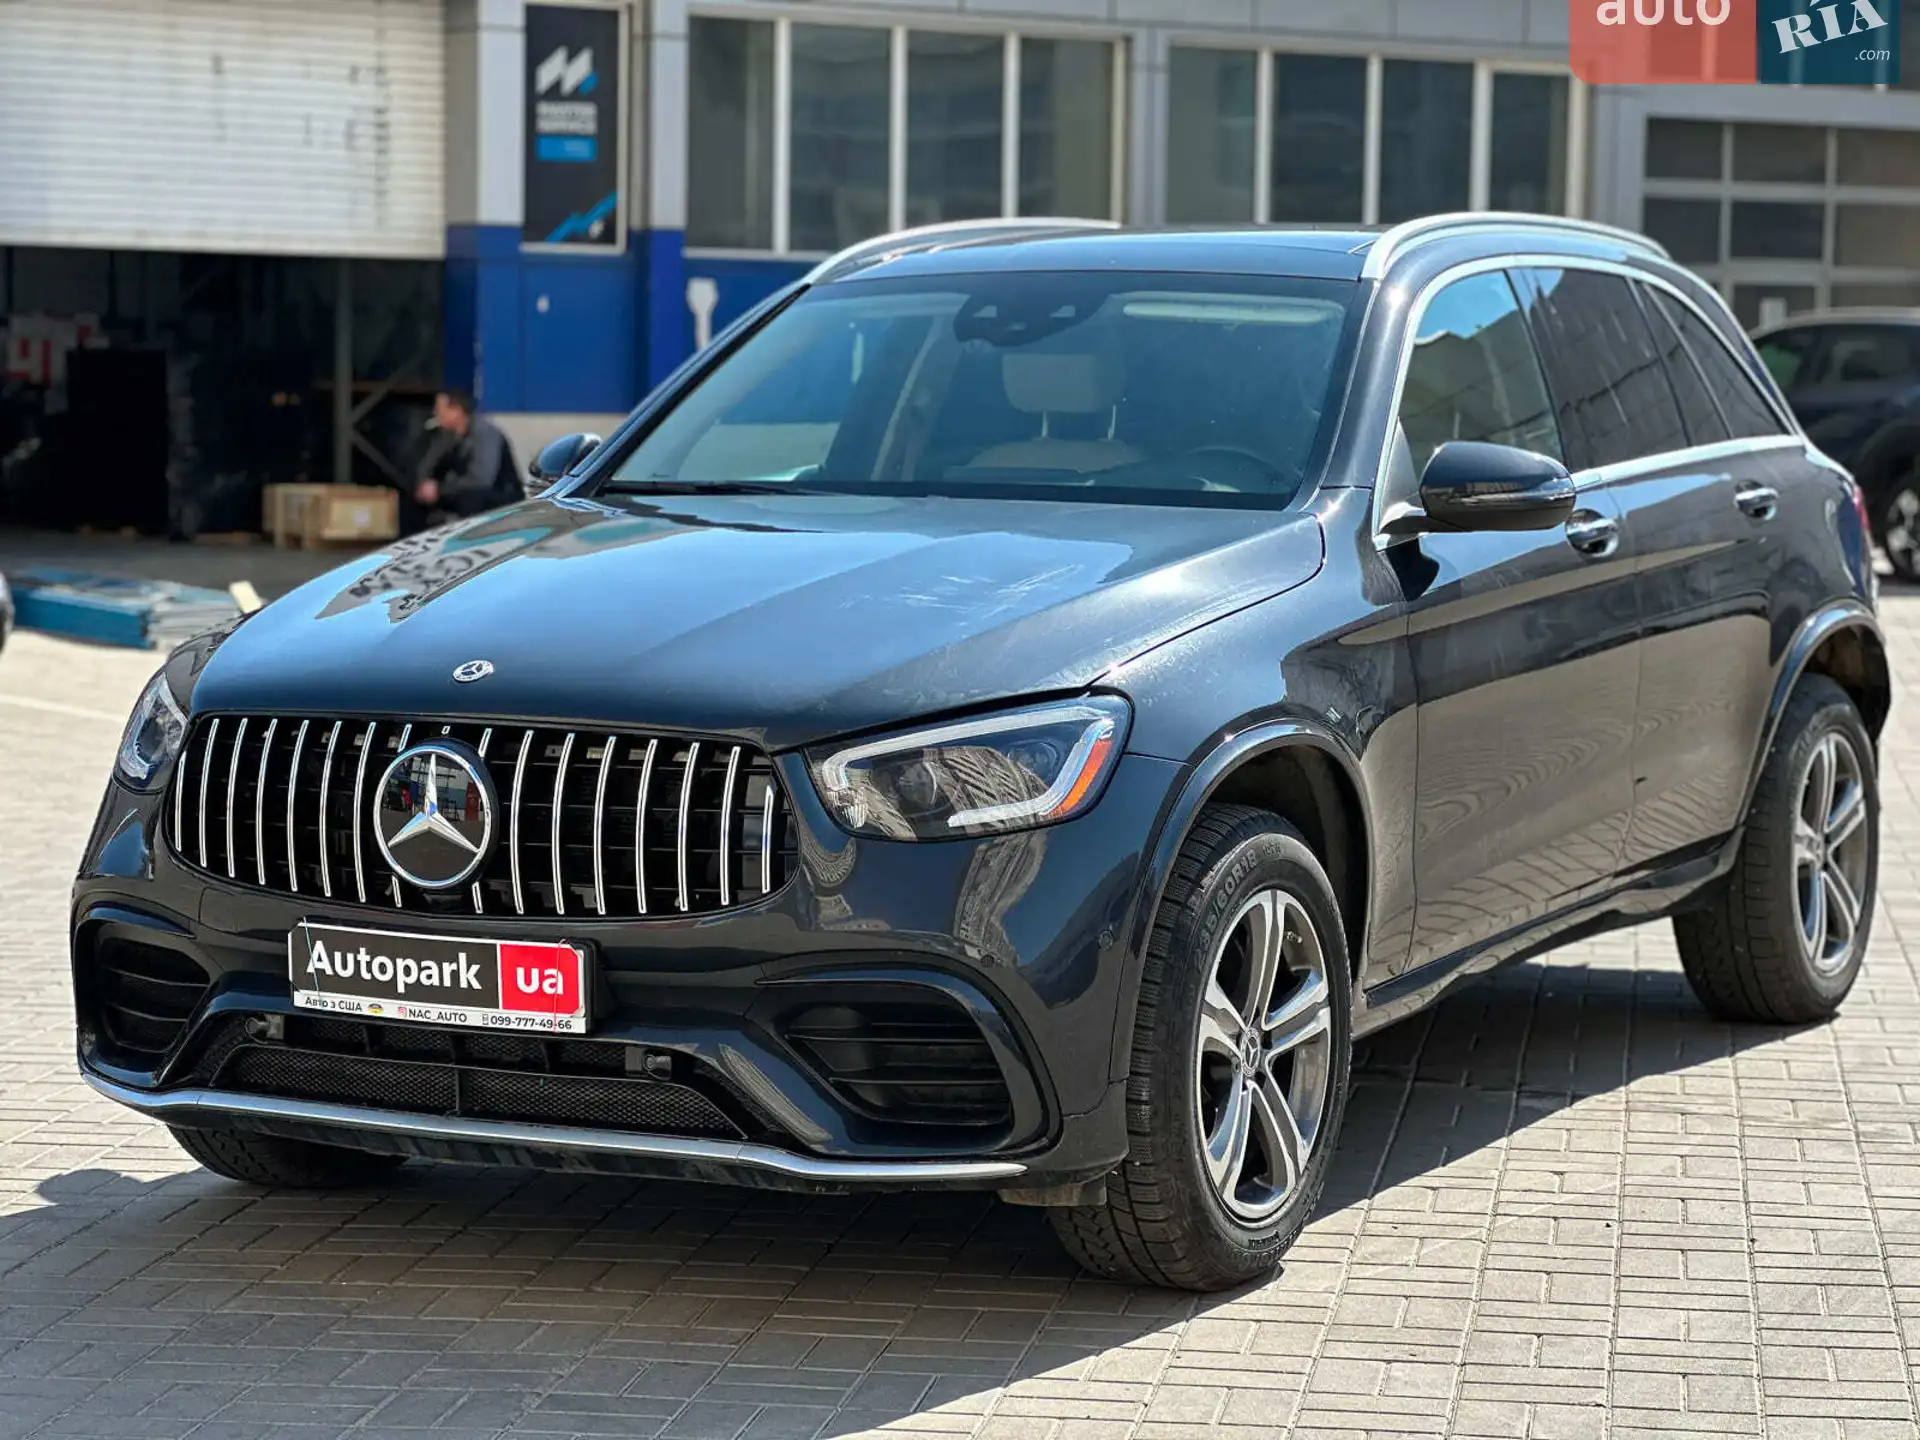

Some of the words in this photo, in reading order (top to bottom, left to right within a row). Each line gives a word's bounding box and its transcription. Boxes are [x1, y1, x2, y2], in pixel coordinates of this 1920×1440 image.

[306, 940, 482, 993] Autopark
[515, 964, 565, 996] ua
[338, 1001, 362, 1012] США
[408, 1008, 467, 1023] NAC_AUTO
[491, 1016, 572, 1030] 099-777-49-66
